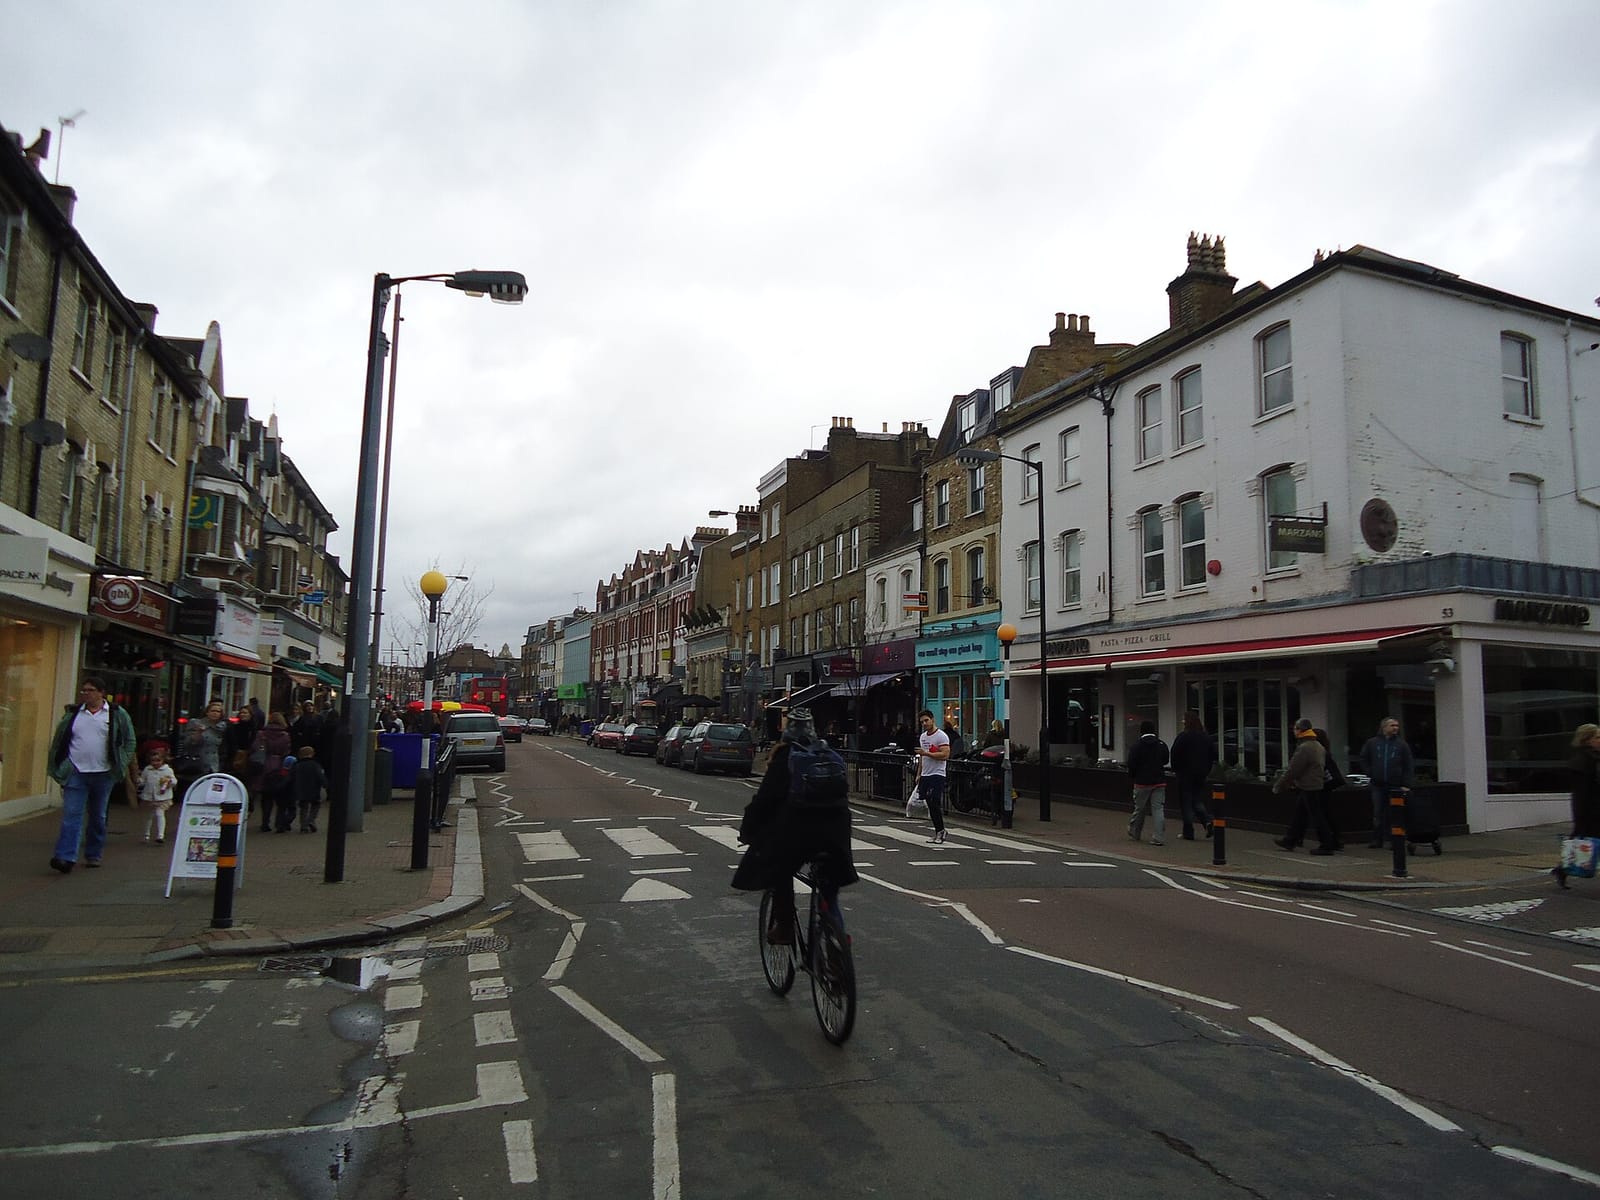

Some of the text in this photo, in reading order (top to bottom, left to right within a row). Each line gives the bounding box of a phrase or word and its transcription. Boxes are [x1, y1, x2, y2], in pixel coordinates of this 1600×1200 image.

[1278, 526, 1324, 539] MARZANO
[111, 588, 130, 600] gbk
[1441, 607, 1454, 619] 53
[1495, 599, 1590, 625] MARZANO
[1100, 639, 1119, 648] PASTA
[1124, 636, 1144, 646] PIZZA
[1149, 632, 1171, 642] GRILL
[958, 644, 971, 655] giant
